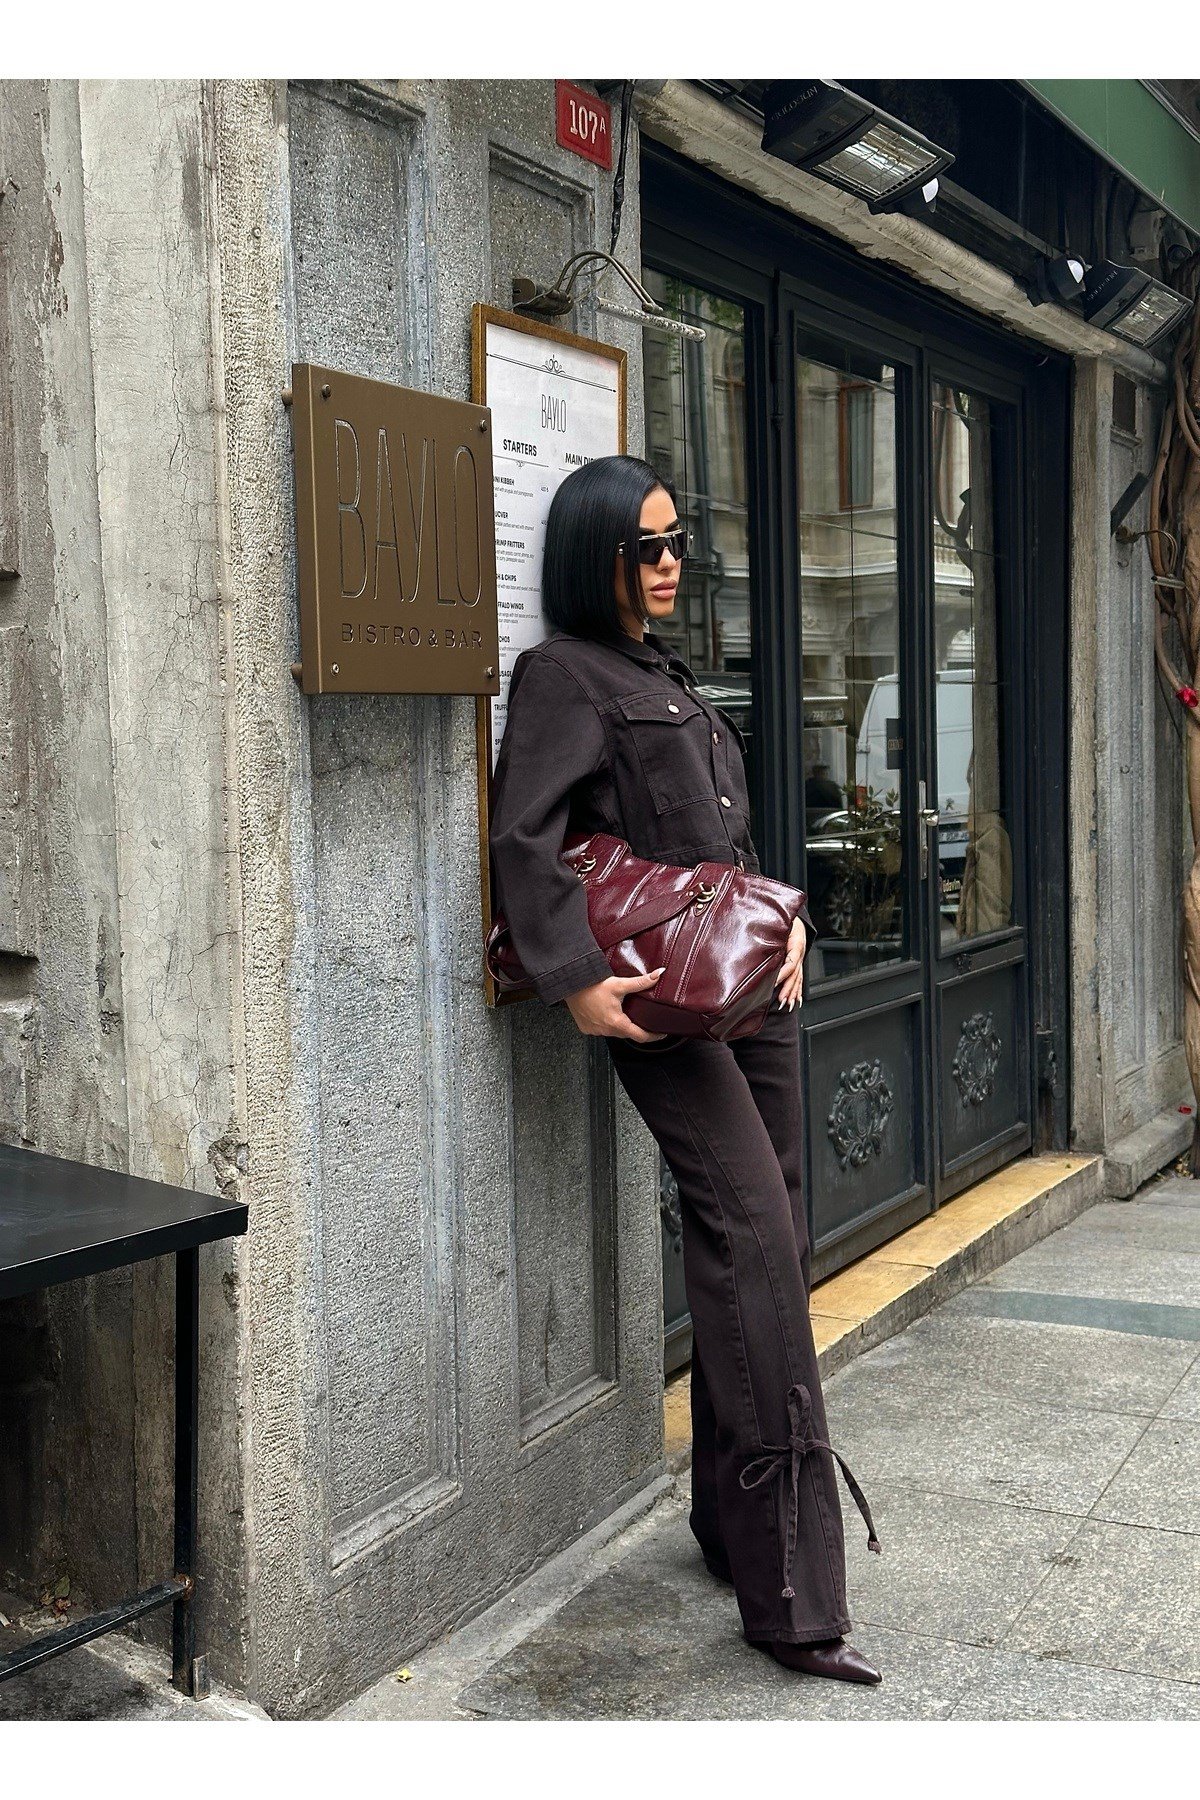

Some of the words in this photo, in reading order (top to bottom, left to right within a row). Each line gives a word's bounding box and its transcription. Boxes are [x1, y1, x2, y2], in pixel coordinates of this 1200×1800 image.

[541, 393, 567, 433] BAYLO
[503, 438, 538, 457] STARTERS
[565, 452, 583, 466] MAIN
[334, 418, 483, 608] BAYLO
[341, 622, 421, 648] BISTRO
[428, 629, 439, 648] &
[445, 629, 483, 650] BAR
